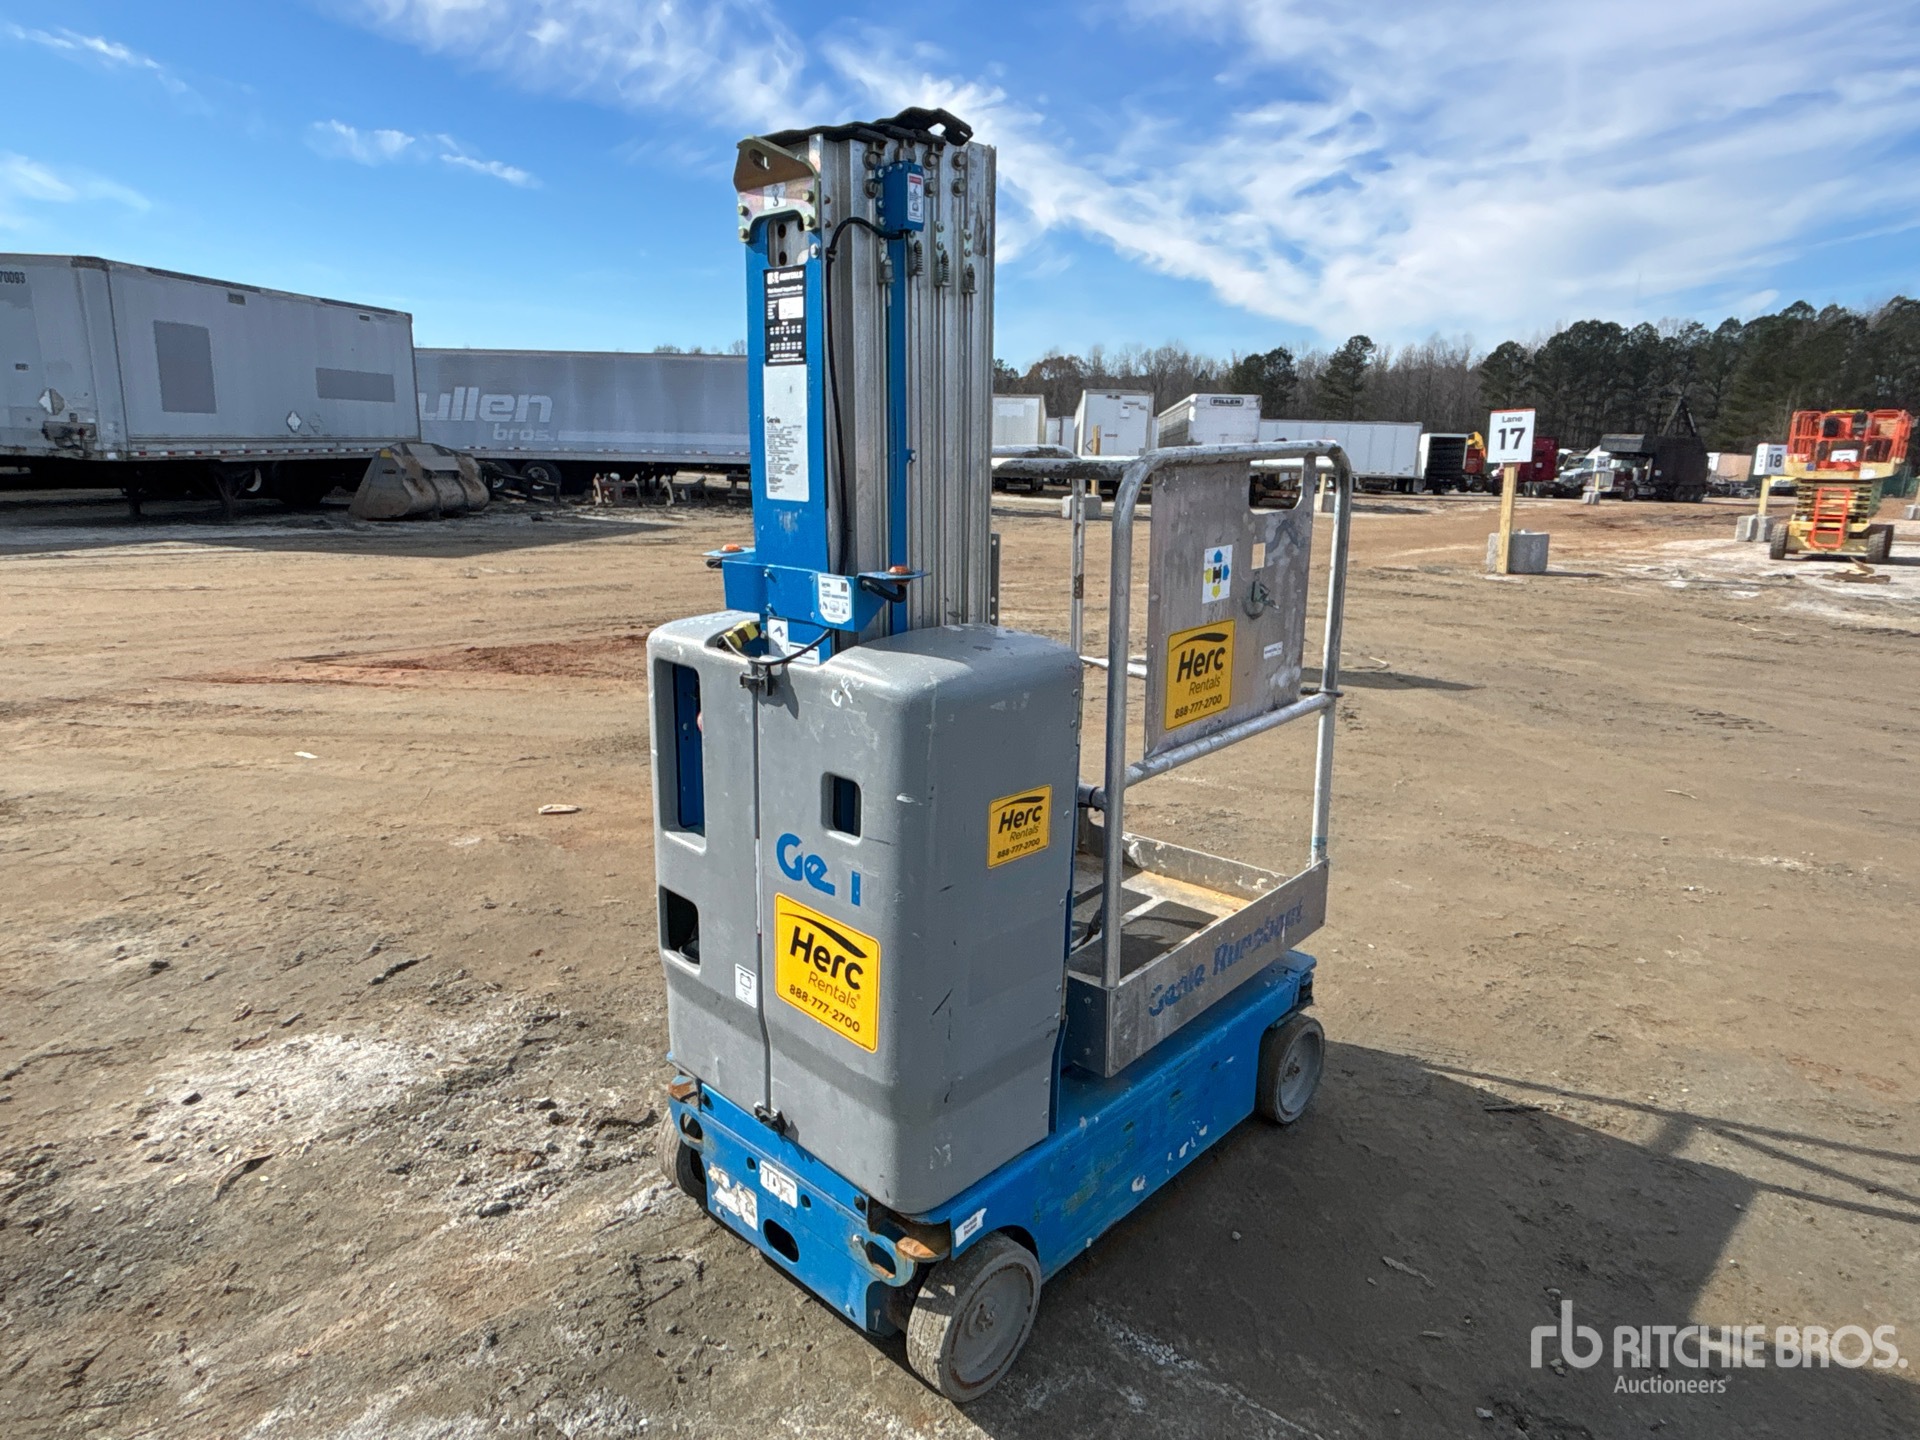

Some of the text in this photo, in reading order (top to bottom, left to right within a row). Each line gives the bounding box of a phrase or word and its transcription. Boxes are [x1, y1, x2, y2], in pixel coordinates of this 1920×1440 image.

[493, 423, 555, 441] bros.
[1498, 427, 1526, 450] 17
[1768, 453, 1783, 468] 18
[1176, 647, 1226, 683] Herc
[1189, 675, 1221, 697] Rentals
[1175, 694, 1222, 719] 888-777-2700
[998, 805, 1043, 834] Herc
[1009, 825, 1039, 842] Rentals
[997, 838, 1041, 859] 888-777-2700
[790, 926, 863, 990] Herc
[808, 970, 857, 1010] Rentals
[789, 984, 860, 1033] 888-777-2700
